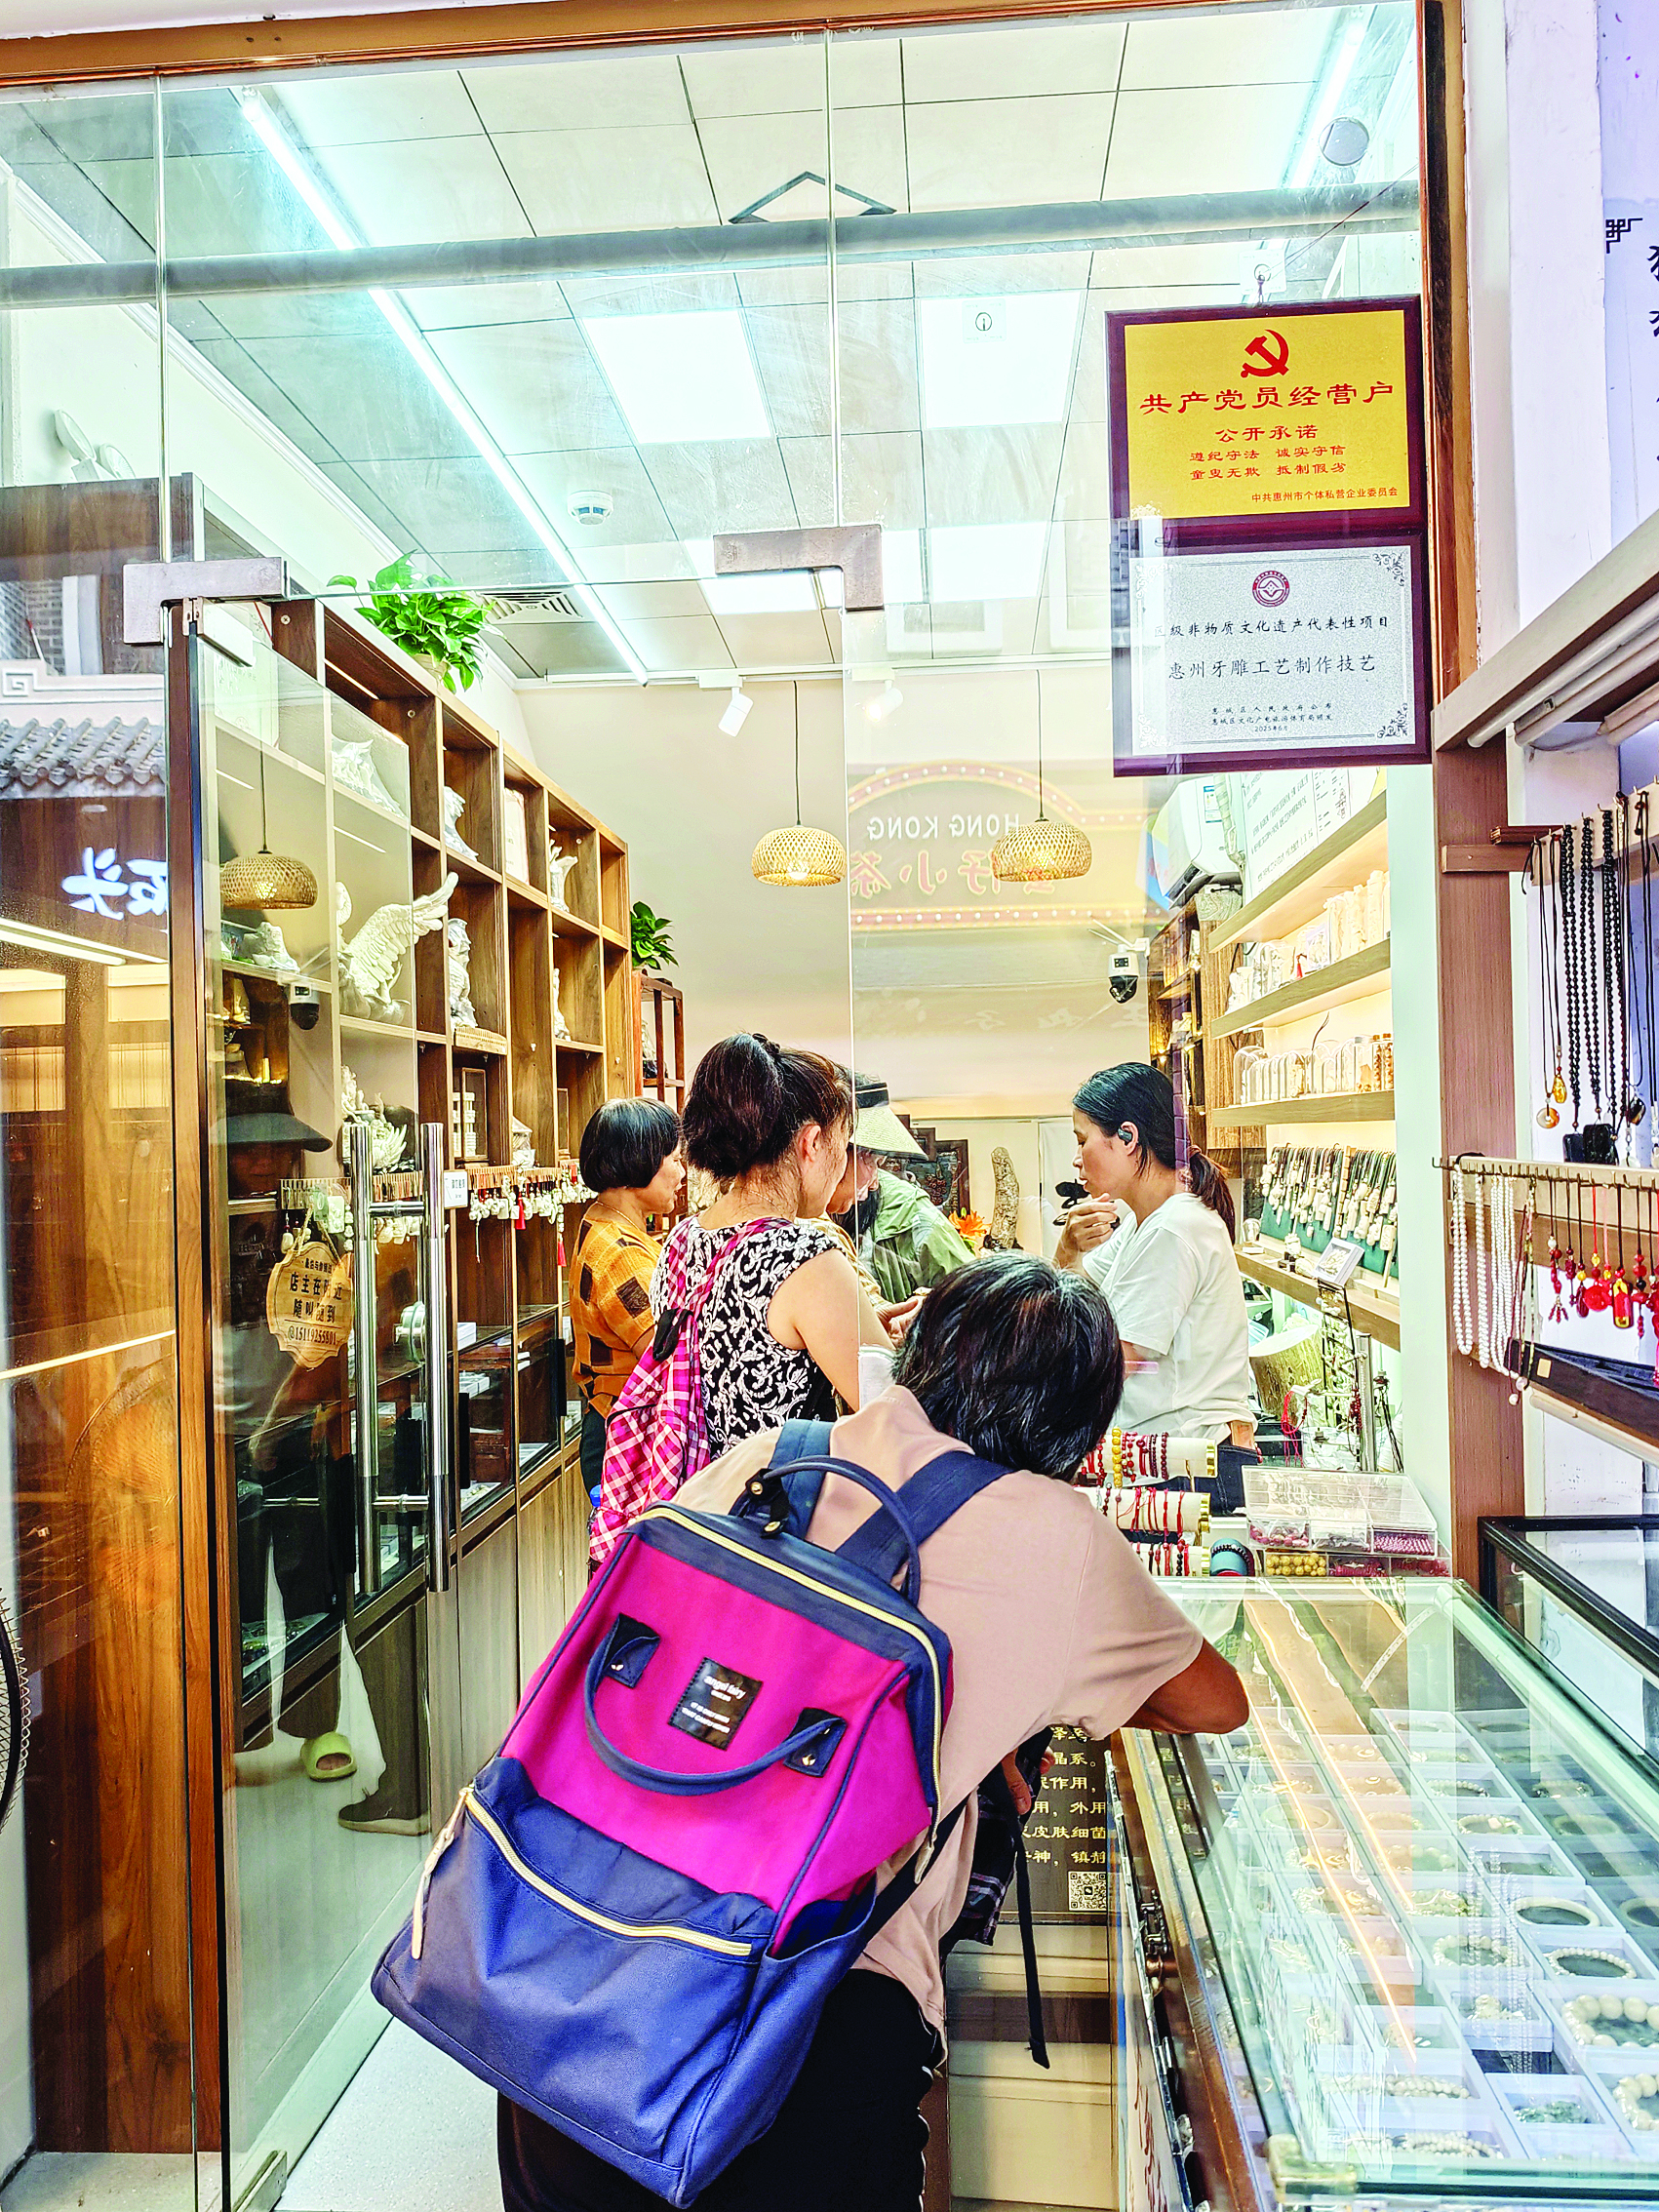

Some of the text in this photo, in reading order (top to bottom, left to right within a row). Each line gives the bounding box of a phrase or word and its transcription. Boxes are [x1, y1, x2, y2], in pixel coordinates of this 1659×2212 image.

[1139, 381, 1394, 415] 共产党员经营户
[1215, 424, 1319, 443] 公开承诺
[1189, 444, 1346, 462] 遵纪守法 诚实守信
[1190, 461, 1347, 481] 童叟无欺 抵制假劣
[1251, 486, 1399, 503] 中共惠州市个体私营企业委员会
[1168, 653, 1376, 680] 惠州牙雕工艺制作技艺
